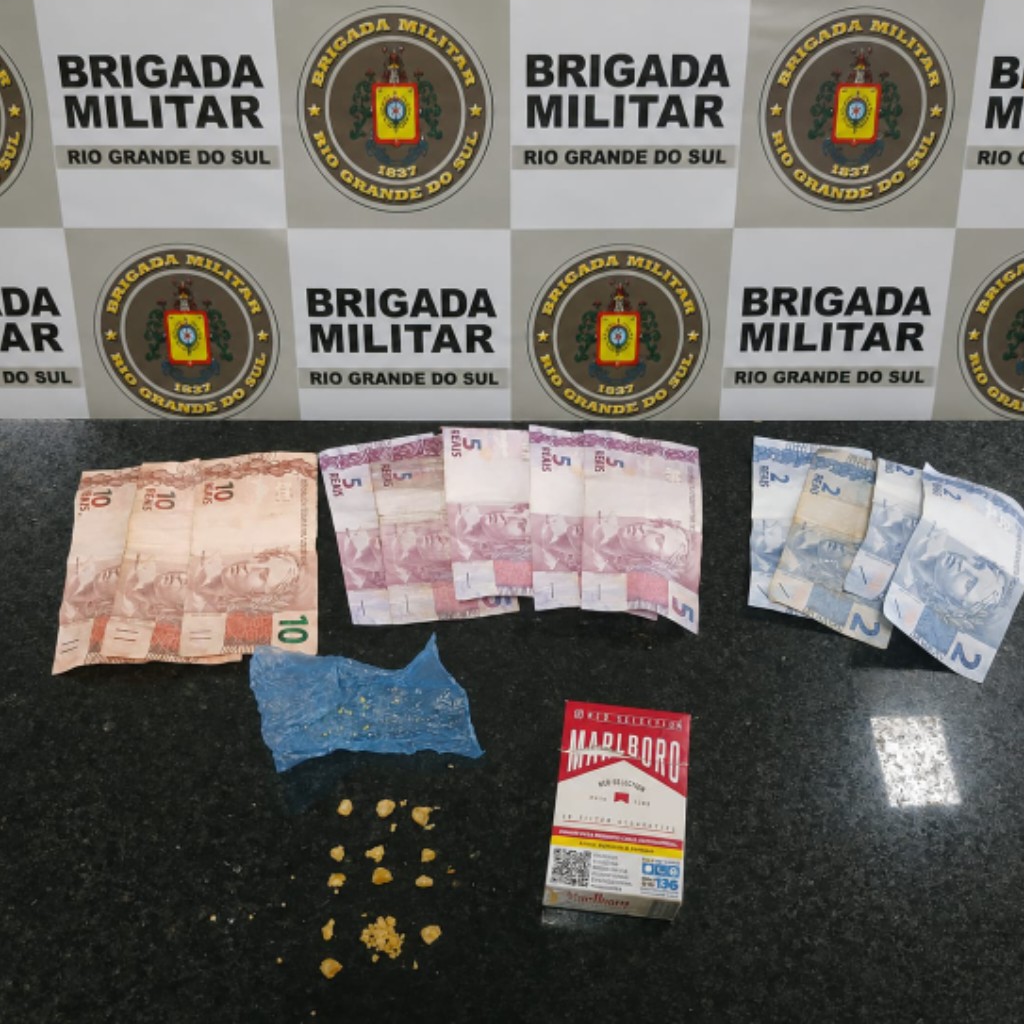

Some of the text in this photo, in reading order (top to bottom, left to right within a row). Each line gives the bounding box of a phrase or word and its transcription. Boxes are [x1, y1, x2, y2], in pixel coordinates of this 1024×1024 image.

[311, 18, 475, 88] BRIGADA MILITAR
[58, 54, 263, 88] BRIGADA
[526, 54, 729, 87] BRIGADA
[64, 96, 263, 128] MILITAR
[527, 94, 724, 128] MILITAR
[68, 149, 270, 164] RIO GRANDE DO SUL
[315, 130, 479, 202] RIO GRANDE DO SUL
[524, 149, 726, 164] RIO GRANDE DO SUL
[978, 150, 1012, 165] RIO
[377, 164, 418, 180] 1837
[0, 287, 60, 316] DA
[306, 288, 496, 318] BRIGADA
[742, 286, 931, 316] BRIGADA
[310, 324, 494, 353] MILITAR
[740, 322, 924, 352] MILITAR
[2, 371, 72, 384] DO SUL
[310, 372, 498, 385] RIO GRANDE DO SUL
[735, 370, 924, 384] RIO GRANDE DO SUL
[463, 437, 481, 450] 5
[552, 454, 571, 466] 5
[606, 456, 624, 468] 5
[393, 472, 412, 481] 5
[770, 472, 790, 483] 2
[896, 465, 914, 476] 2
[214, 481, 234, 501] 10
[342, 478, 362, 488] 5
[821, 482, 840, 497] 2
[91, 488, 113, 508] 10
[155, 491, 176, 510] 10
[943, 488, 961, 501] 2
[672, 596, 694, 623] 5
[277, 615, 309, 644] 10
[850, 612, 881, 636] 2
[951, 641, 982, 670] 2
[567, 729, 680, 784] MARLBORO
[655, 878, 679, 890] 136
